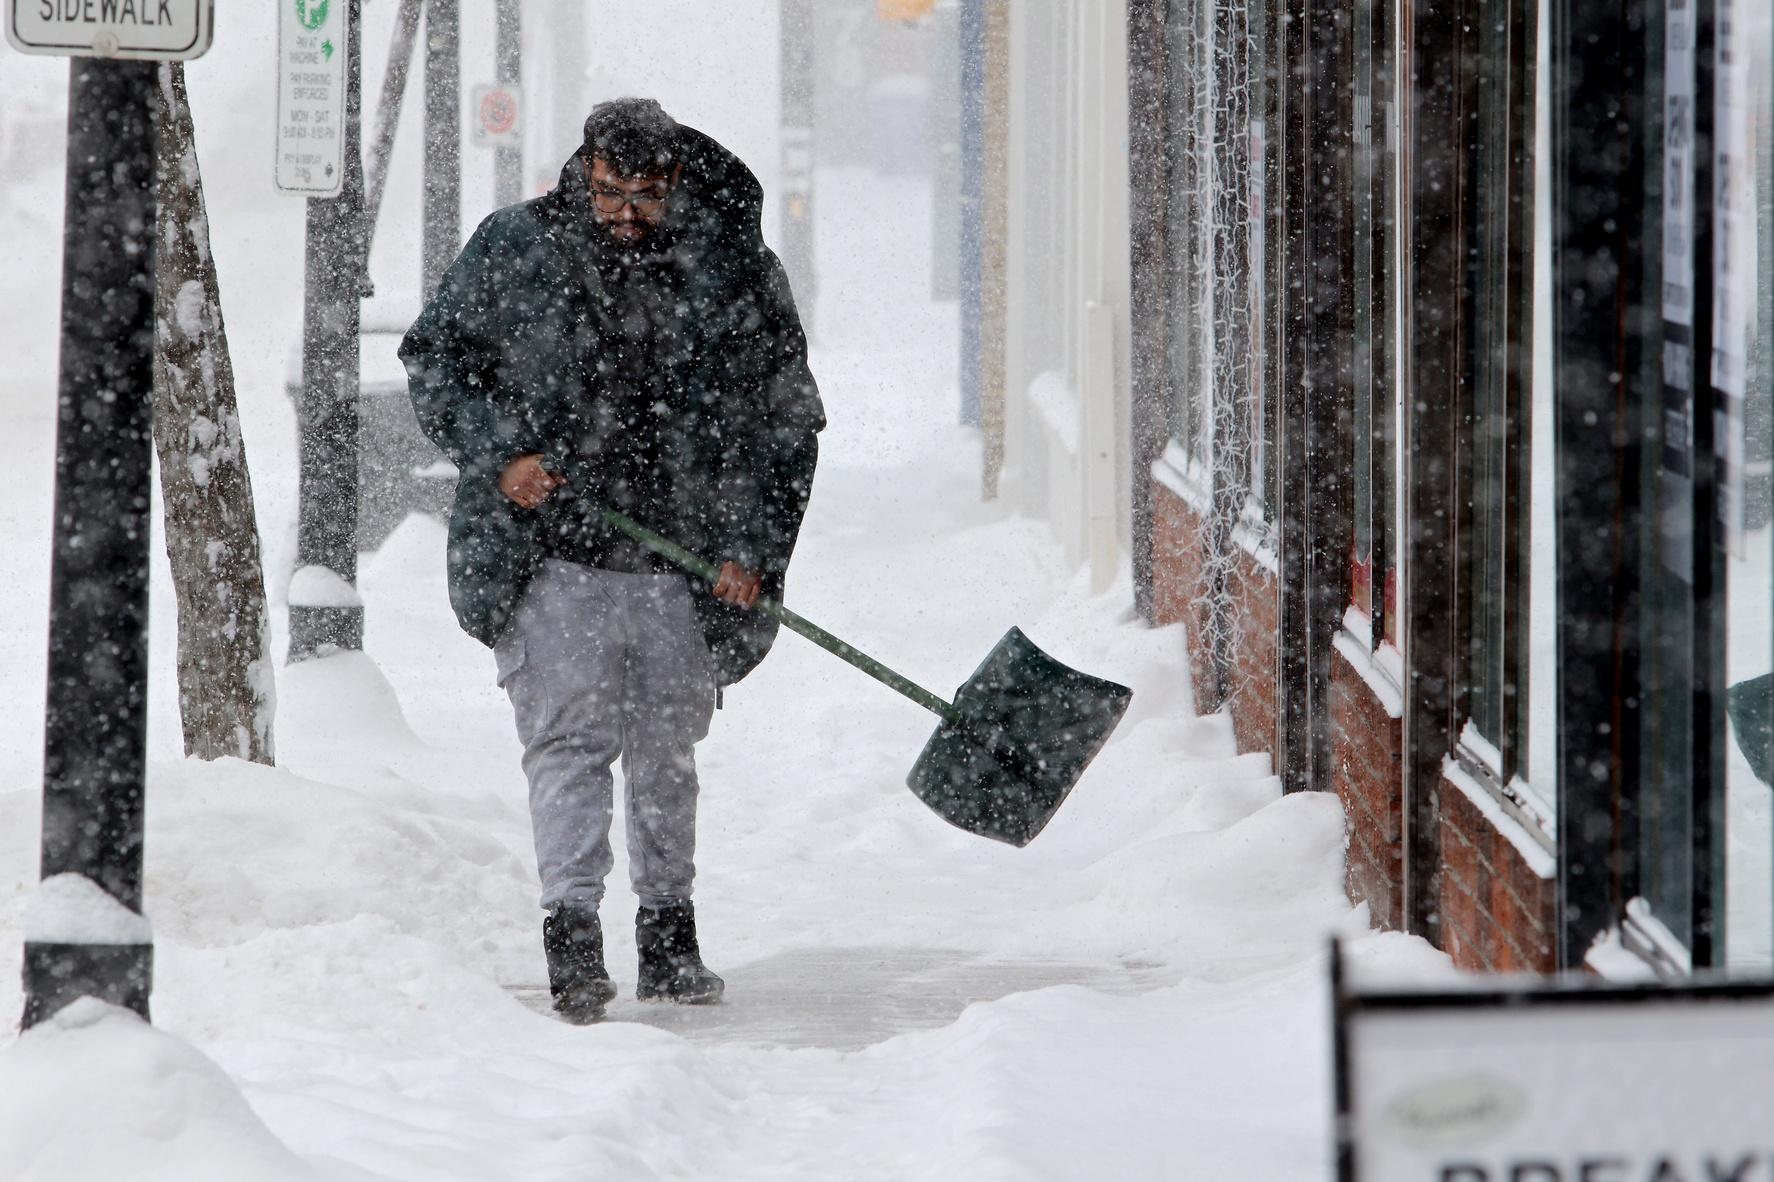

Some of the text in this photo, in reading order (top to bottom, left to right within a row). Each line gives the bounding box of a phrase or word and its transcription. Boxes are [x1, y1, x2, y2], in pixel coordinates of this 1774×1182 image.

[39, 0, 173, 26] SIDEWALK
[290, 110, 308, 121] MON
[315, 110, 329, 122] SAT
